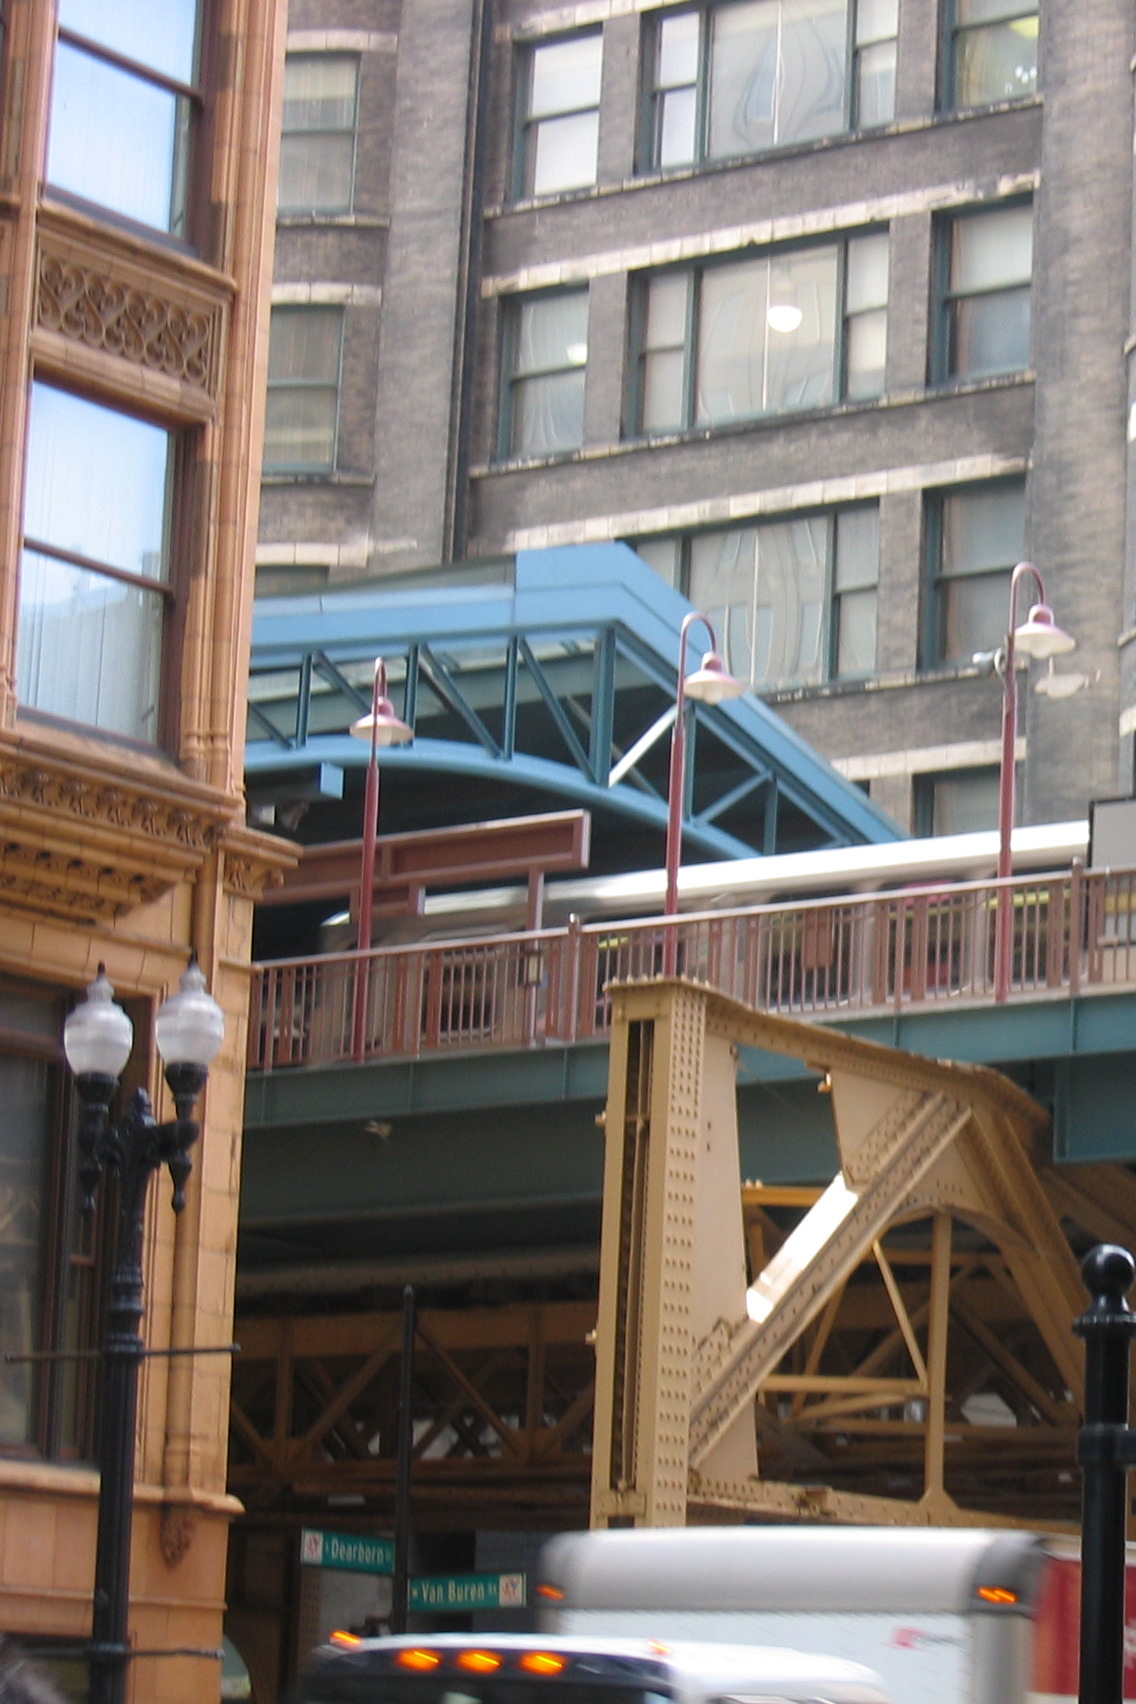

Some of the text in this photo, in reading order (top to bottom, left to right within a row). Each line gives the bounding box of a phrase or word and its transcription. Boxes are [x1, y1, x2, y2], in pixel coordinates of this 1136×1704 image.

[331, 1537, 384, 1565] Dearborn
[422, 1581, 443, 1603] Van
[448, 1580, 484, 1603] Buren
